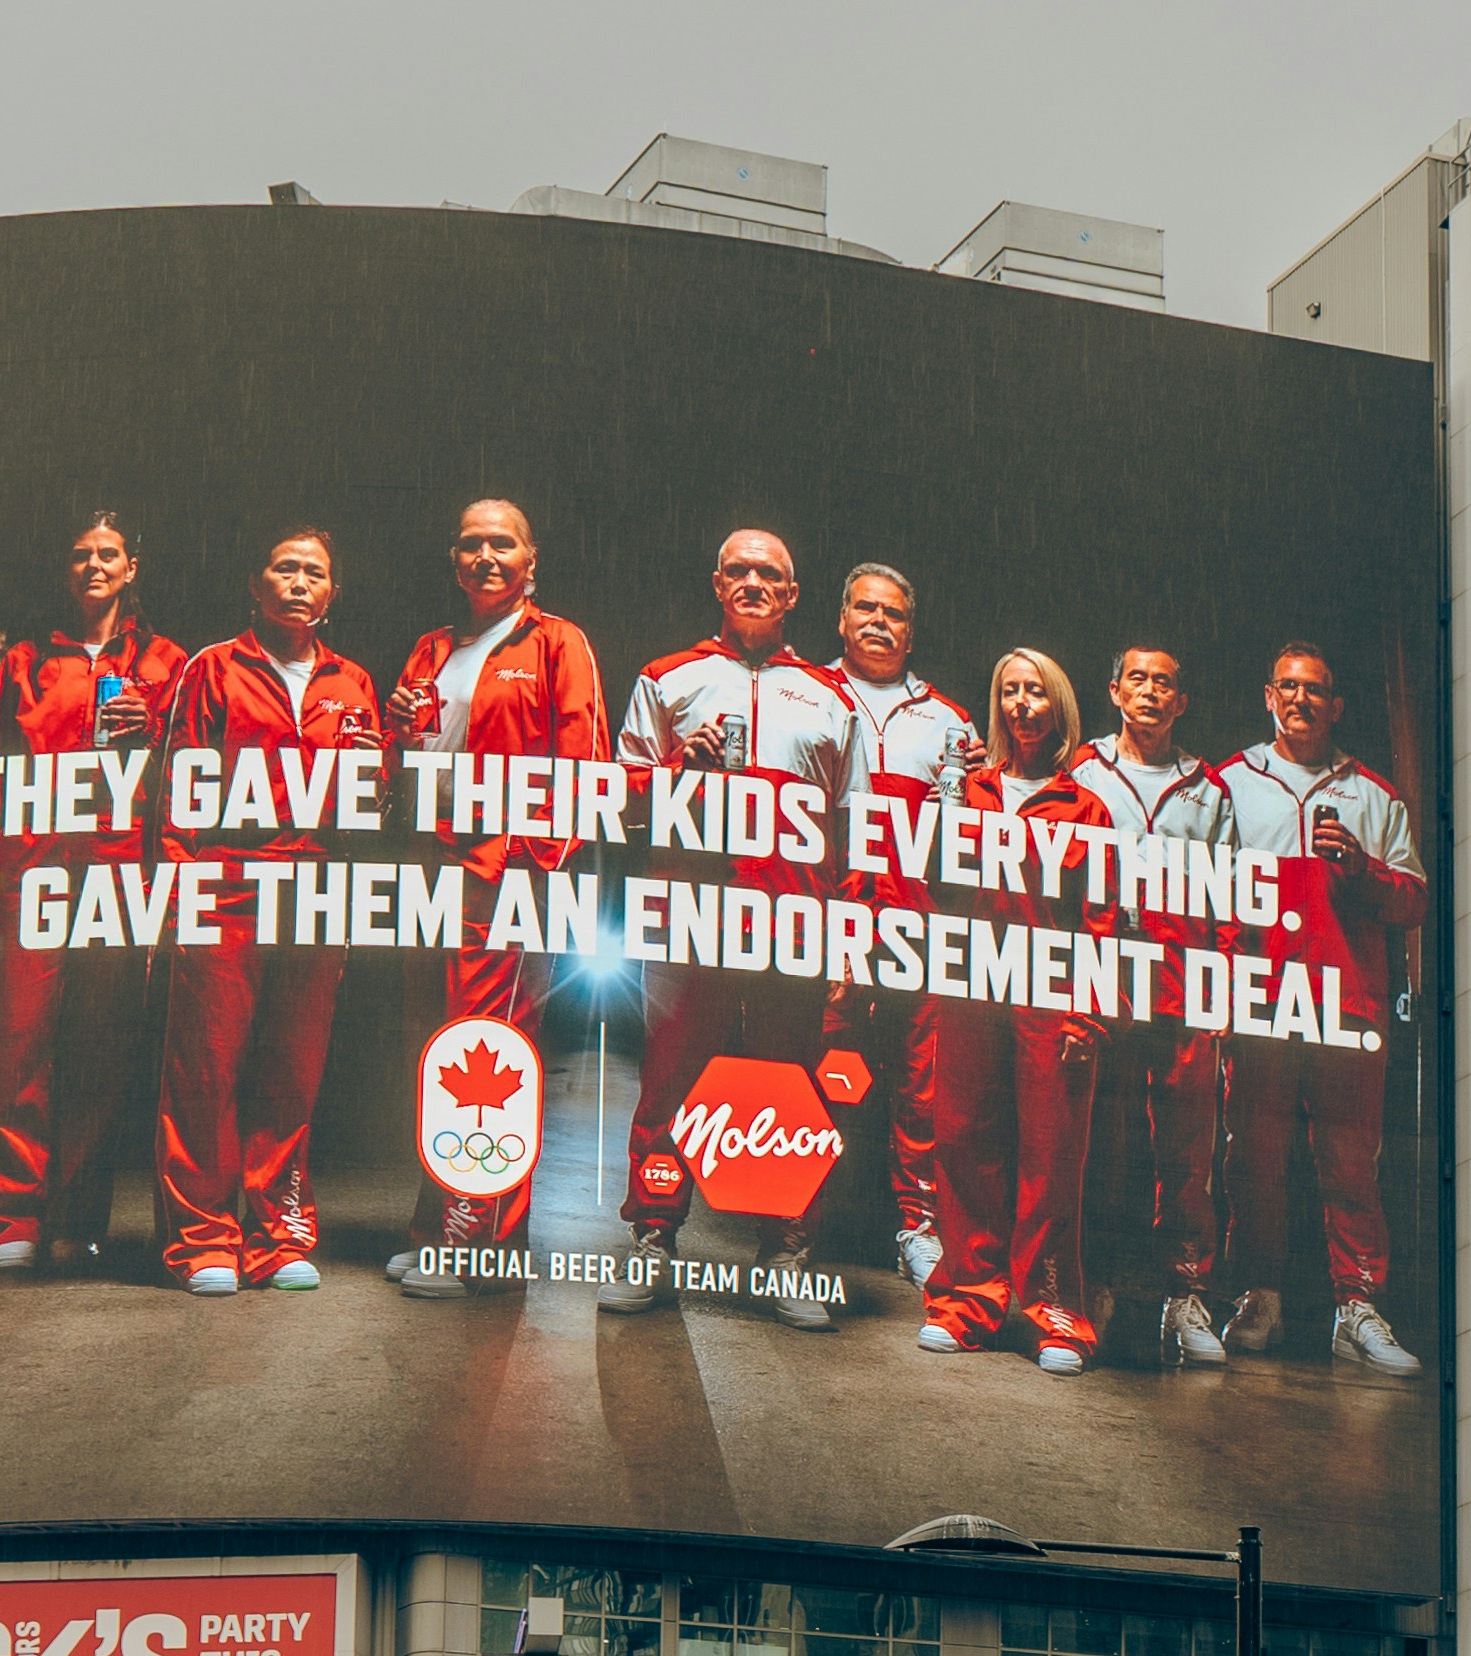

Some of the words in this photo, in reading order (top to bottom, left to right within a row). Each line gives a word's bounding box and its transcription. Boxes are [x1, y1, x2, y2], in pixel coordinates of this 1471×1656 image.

[170, 747, 382, 832] GAVE
[403, 749, 628, 843] THEIR
[650, 764, 828, 865] KIDS
[848, 796, 1302, 933] EVERYTHING.
[19, 861, 224, 951] GAVE
[243, 863, 464, 950] THEM
[485, 870, 598, 956] AN
[624, 875, 1164, 1024] ENDORSEMENT
[1185, 947, 1382, 1053] DEAL.
[643, 1167, 680, 1183] 1786
[670, 1101, 845, 1180] Molson
[419, 1245, 538, 1281] OFFICIAL
[549, 1253, 616, 1285] BEER
[626, 1257, 661, 1287] OF
[670, 1259, 739, 1294] TEAM
[749, 1267, 847, 1305] CANADA
[200, 1611, 311, 1646] PARTY
